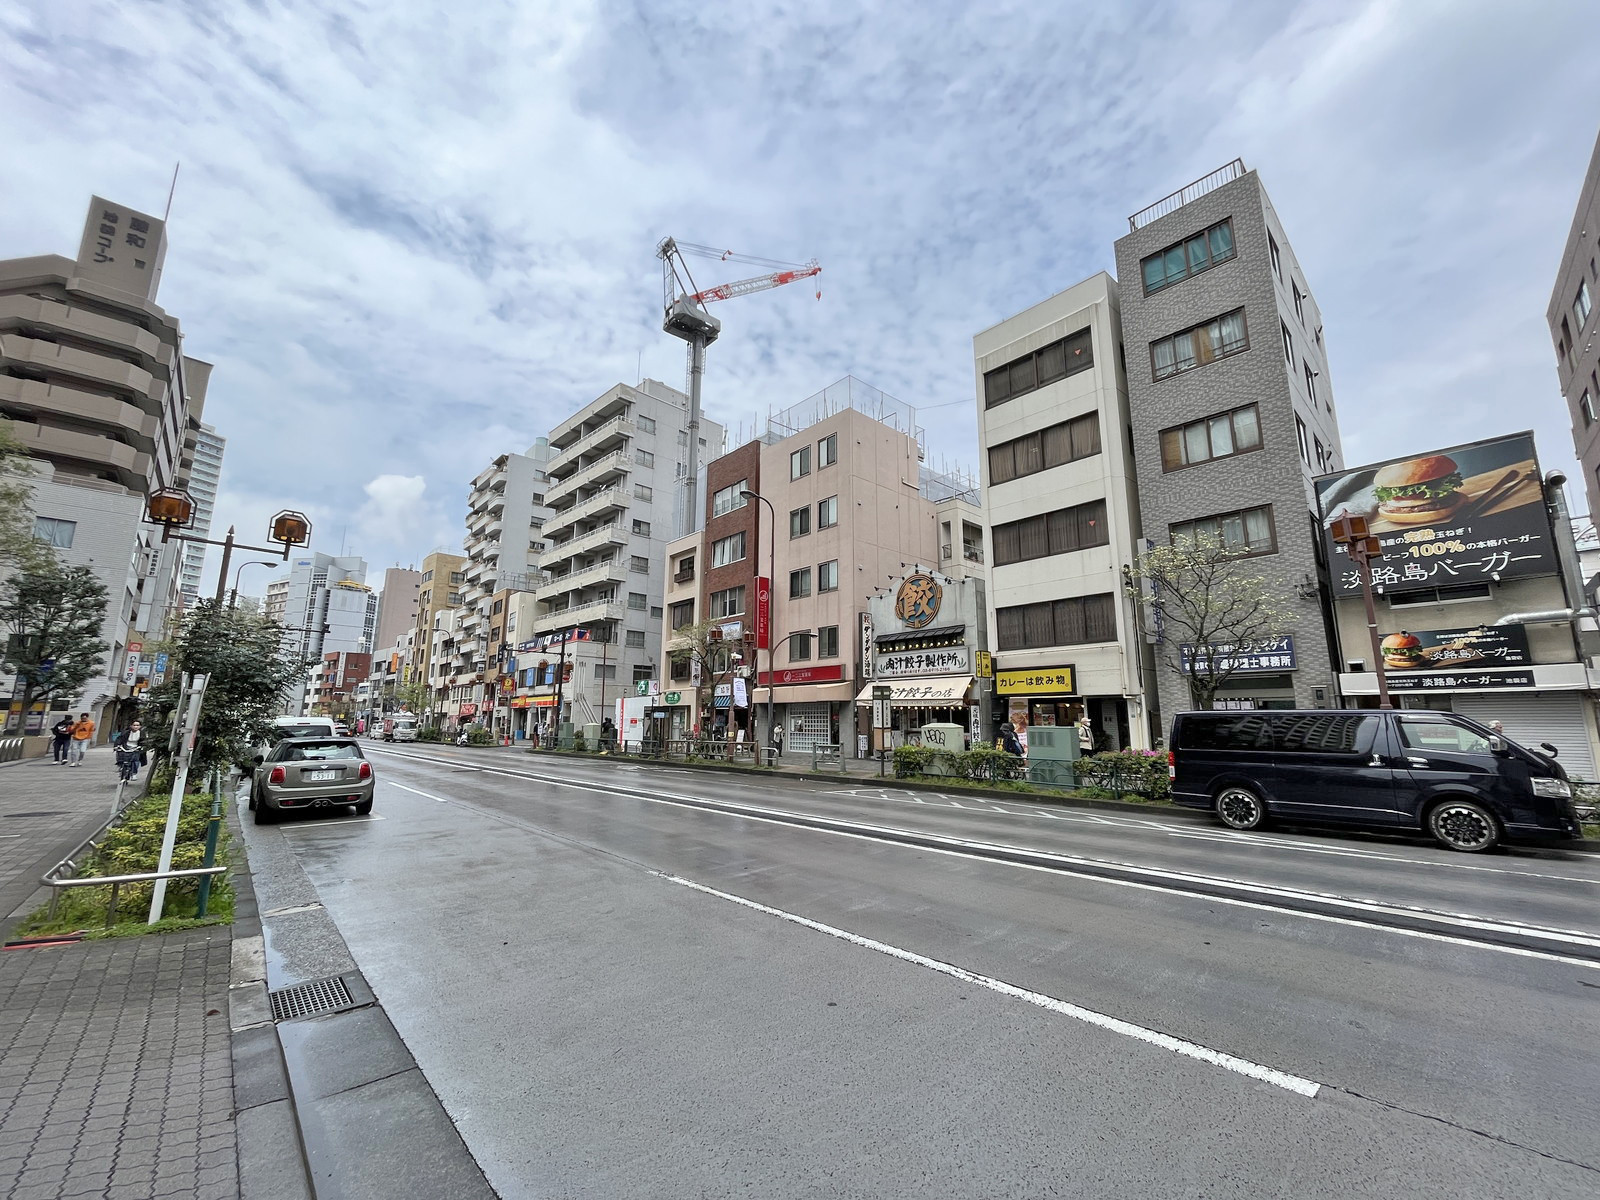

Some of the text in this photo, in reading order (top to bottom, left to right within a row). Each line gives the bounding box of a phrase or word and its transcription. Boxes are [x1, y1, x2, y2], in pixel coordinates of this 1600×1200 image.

[1341, 550, 1542, 589] 淡路島バーガー
[899, 579, 934, 620] 餃
[886, 652, 959, 671] 肉汁餃子製作所
[1429, 646, 1522, 661] 淡路島バーガー
[1422, 675, 1502, 687] 淡路島バーガー
